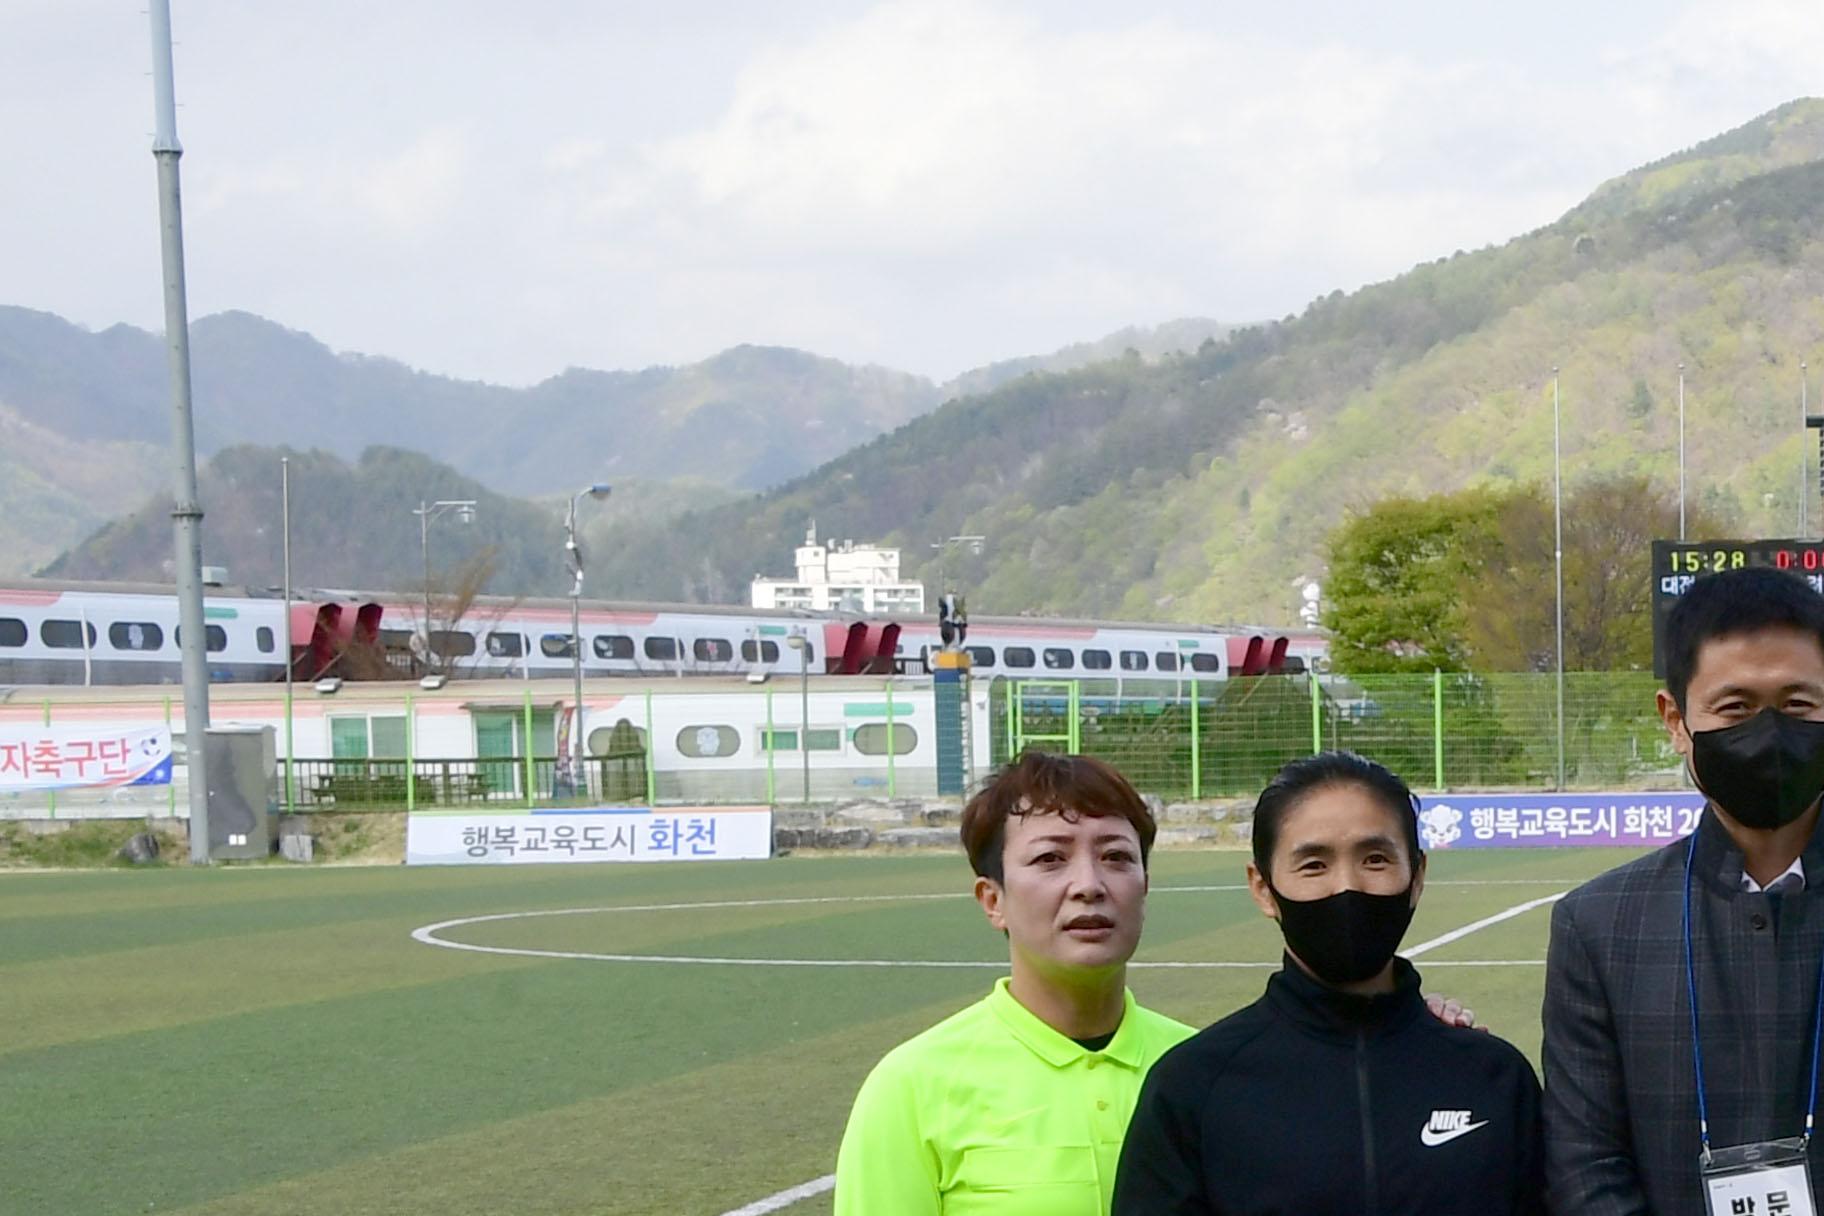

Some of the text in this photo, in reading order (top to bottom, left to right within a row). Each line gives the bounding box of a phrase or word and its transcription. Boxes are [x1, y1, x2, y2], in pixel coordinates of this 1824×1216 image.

[1670, 551, 1745, 572] 15:28
[1469, 806, 1617, 839] 행복교육도시
[1623, 805, 1673, 838] 화천
[461, 818, 718, 857] 행복교육도시 화천
[1429, 1110, 1473, 1131] NIKE
